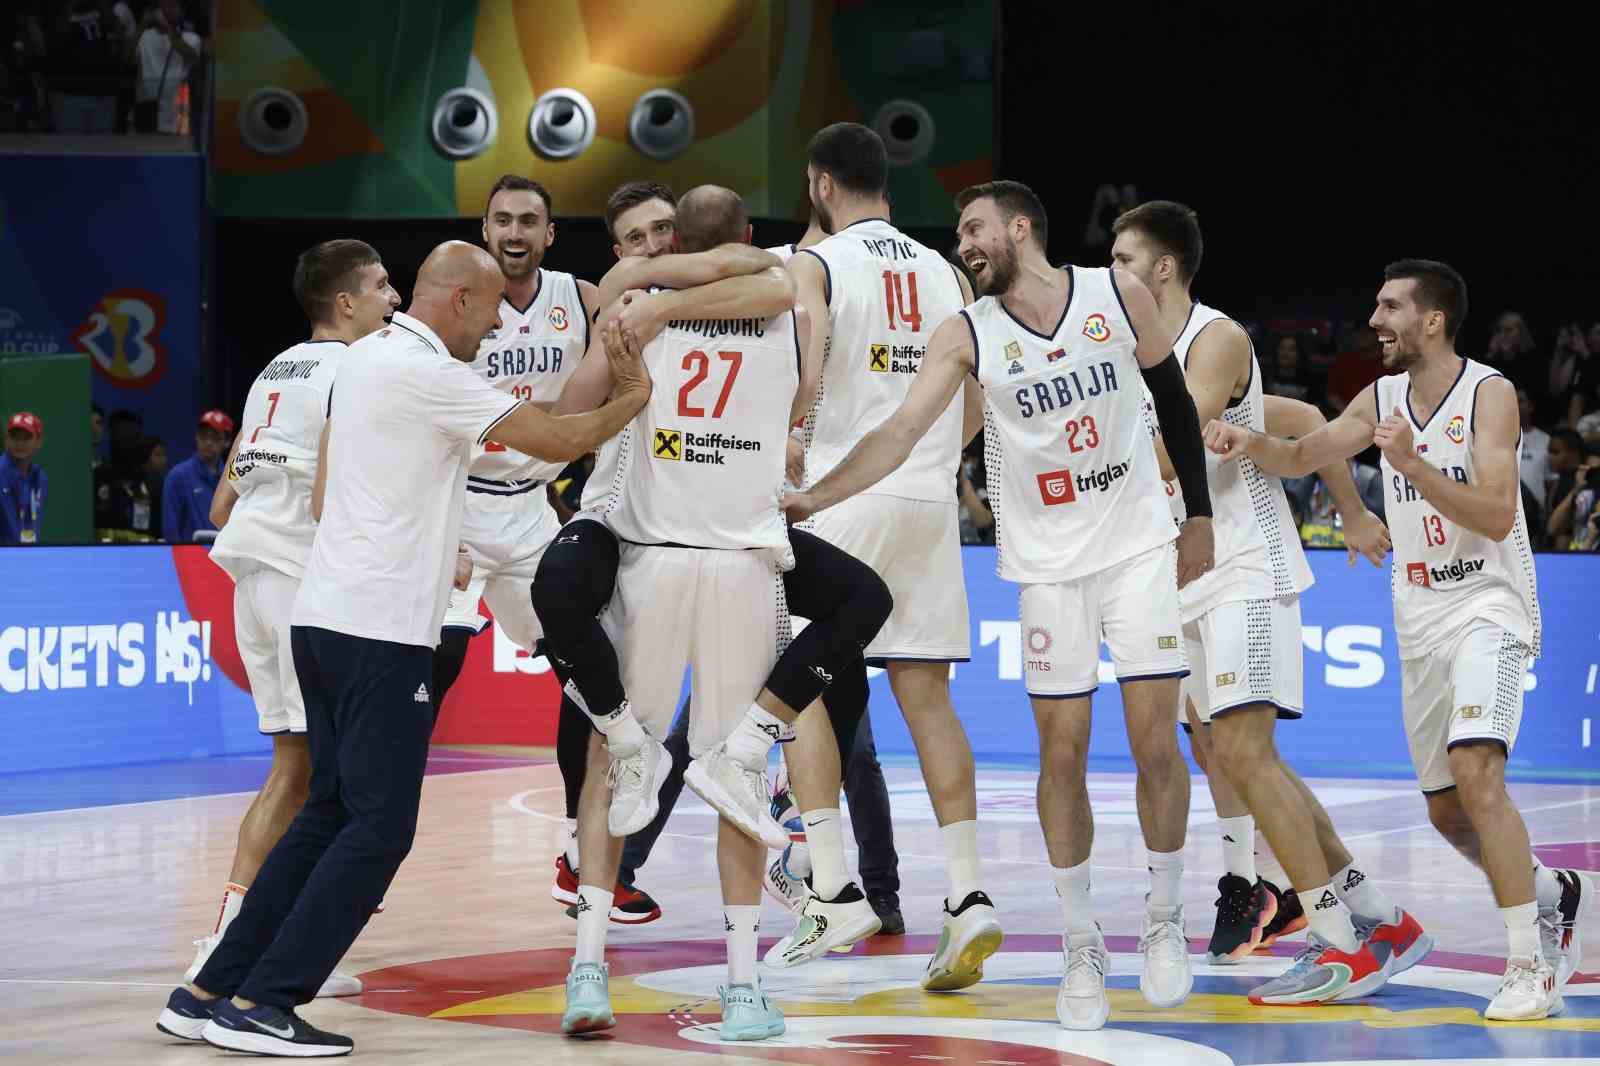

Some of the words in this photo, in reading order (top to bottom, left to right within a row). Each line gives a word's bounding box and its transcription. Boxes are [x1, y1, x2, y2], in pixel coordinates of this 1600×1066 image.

[882, 270, 922, 332] 14
[487, 346, 564, 378] SRBIJA
[677, 350, 743, 419] 27
[1015, 362, 1118, 419] SRBIJA
[250, 392, 281, 443] 7
[1065, 415, 1100, 453] 23
[684, 449, 725, 465] Bank
[685, 432, 761, 452] Raiffeisen
[1422, 514, 1446, 547] 13
[1430, 557, 1485, 583] triglav
[1024, 660, 1051, 672] mts
